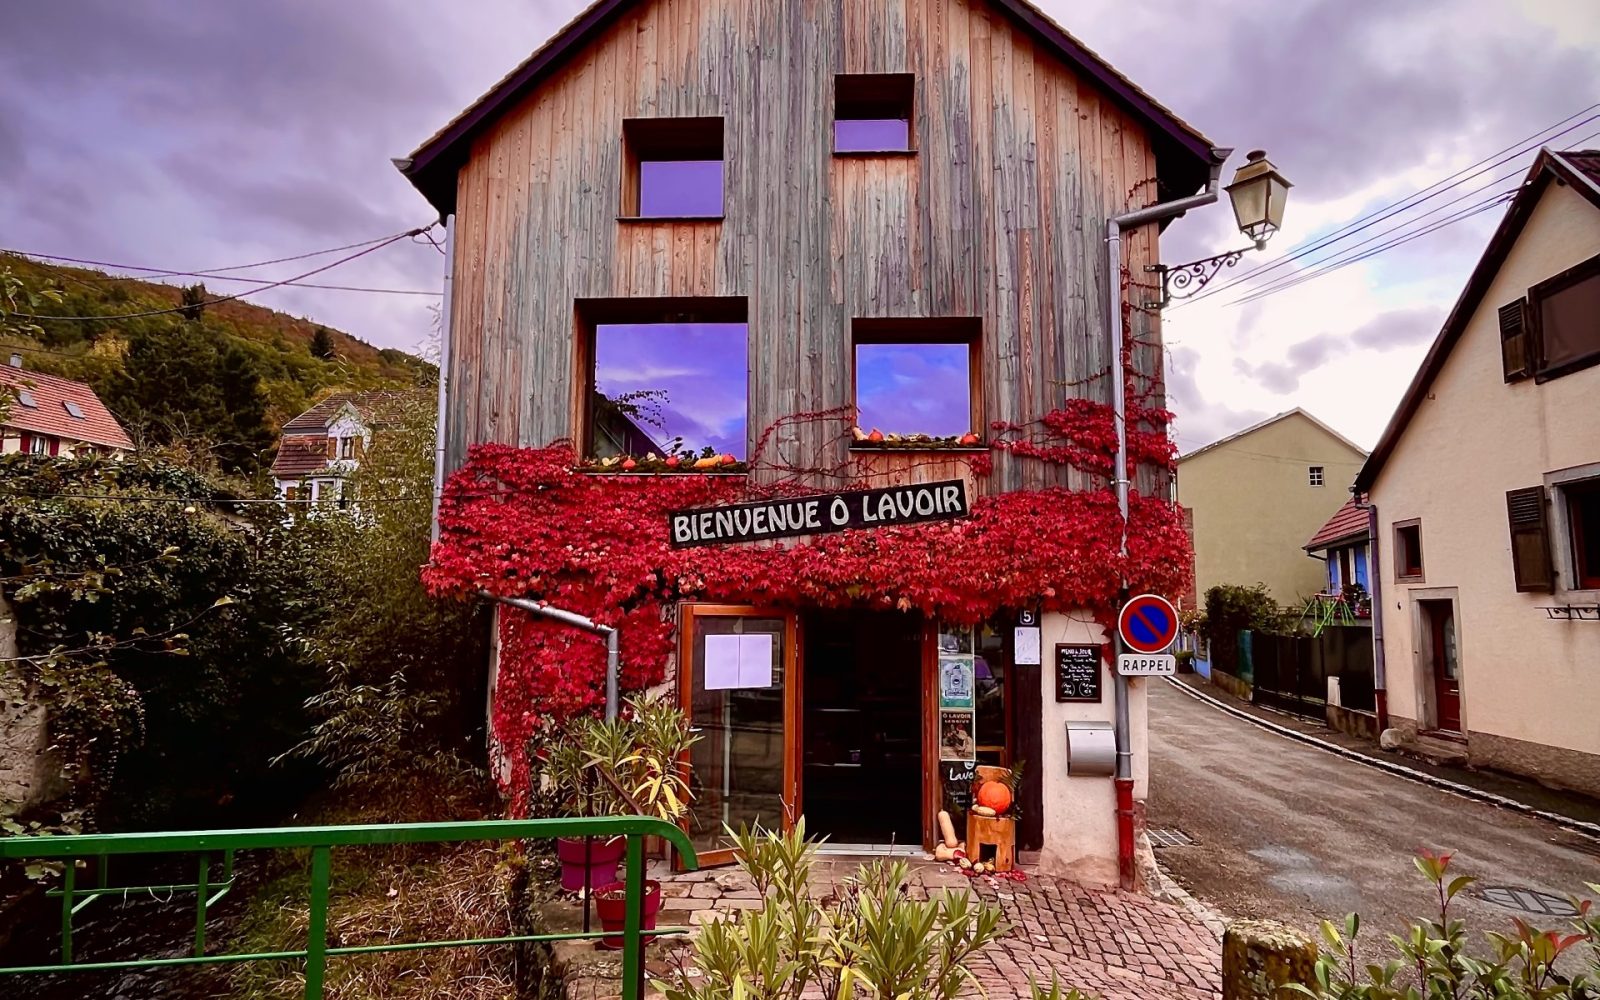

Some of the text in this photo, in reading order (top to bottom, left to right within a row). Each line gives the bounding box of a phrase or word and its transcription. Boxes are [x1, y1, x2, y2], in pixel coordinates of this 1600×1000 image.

[674, 486, 962, 542] BIENVENUE Ô LAVOIR
[1023, 610, 1031, 622] 5
[1123, 660, 1171, 671] RAPPEL
